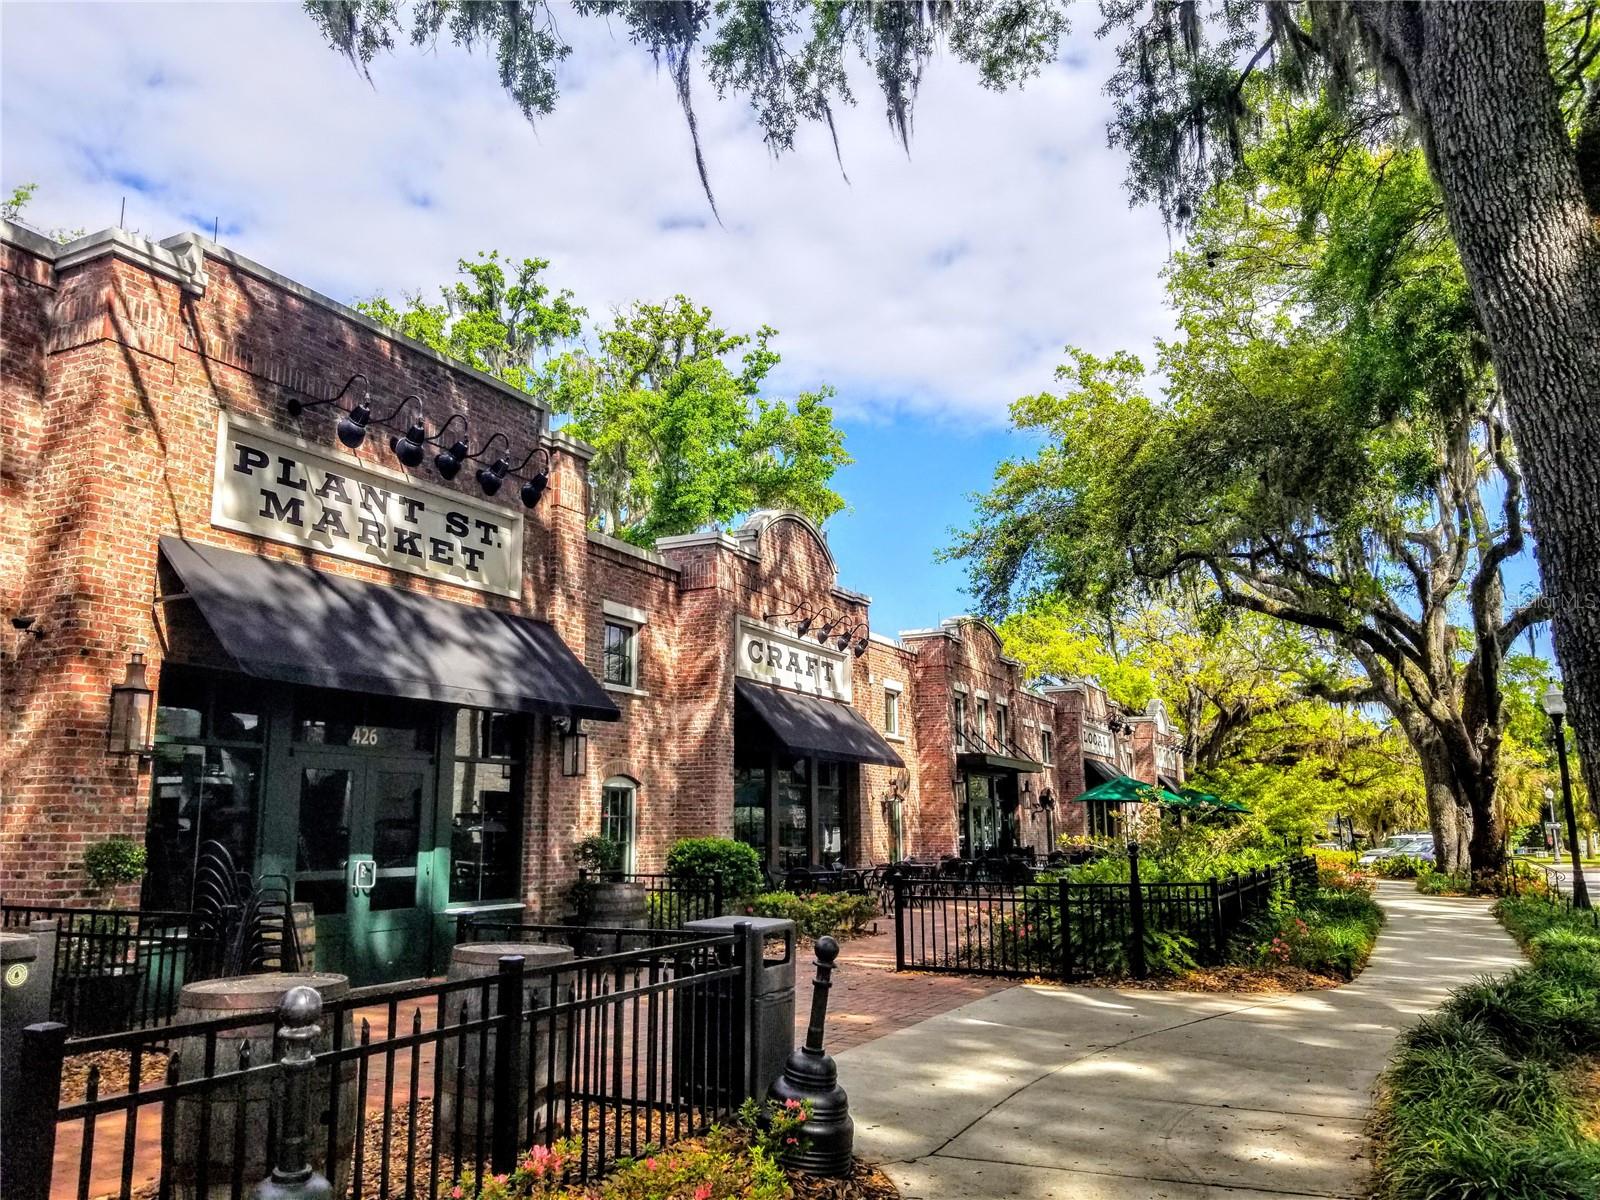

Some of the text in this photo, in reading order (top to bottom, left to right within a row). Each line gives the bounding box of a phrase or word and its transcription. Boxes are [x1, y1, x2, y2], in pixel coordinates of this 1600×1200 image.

[233, 443, 502, 549] PLANT ST.
[259, 488, 484, 573] MARKET
[747, 639, 834, 682] CRAFT
[351, 727, 378, 745] 426
